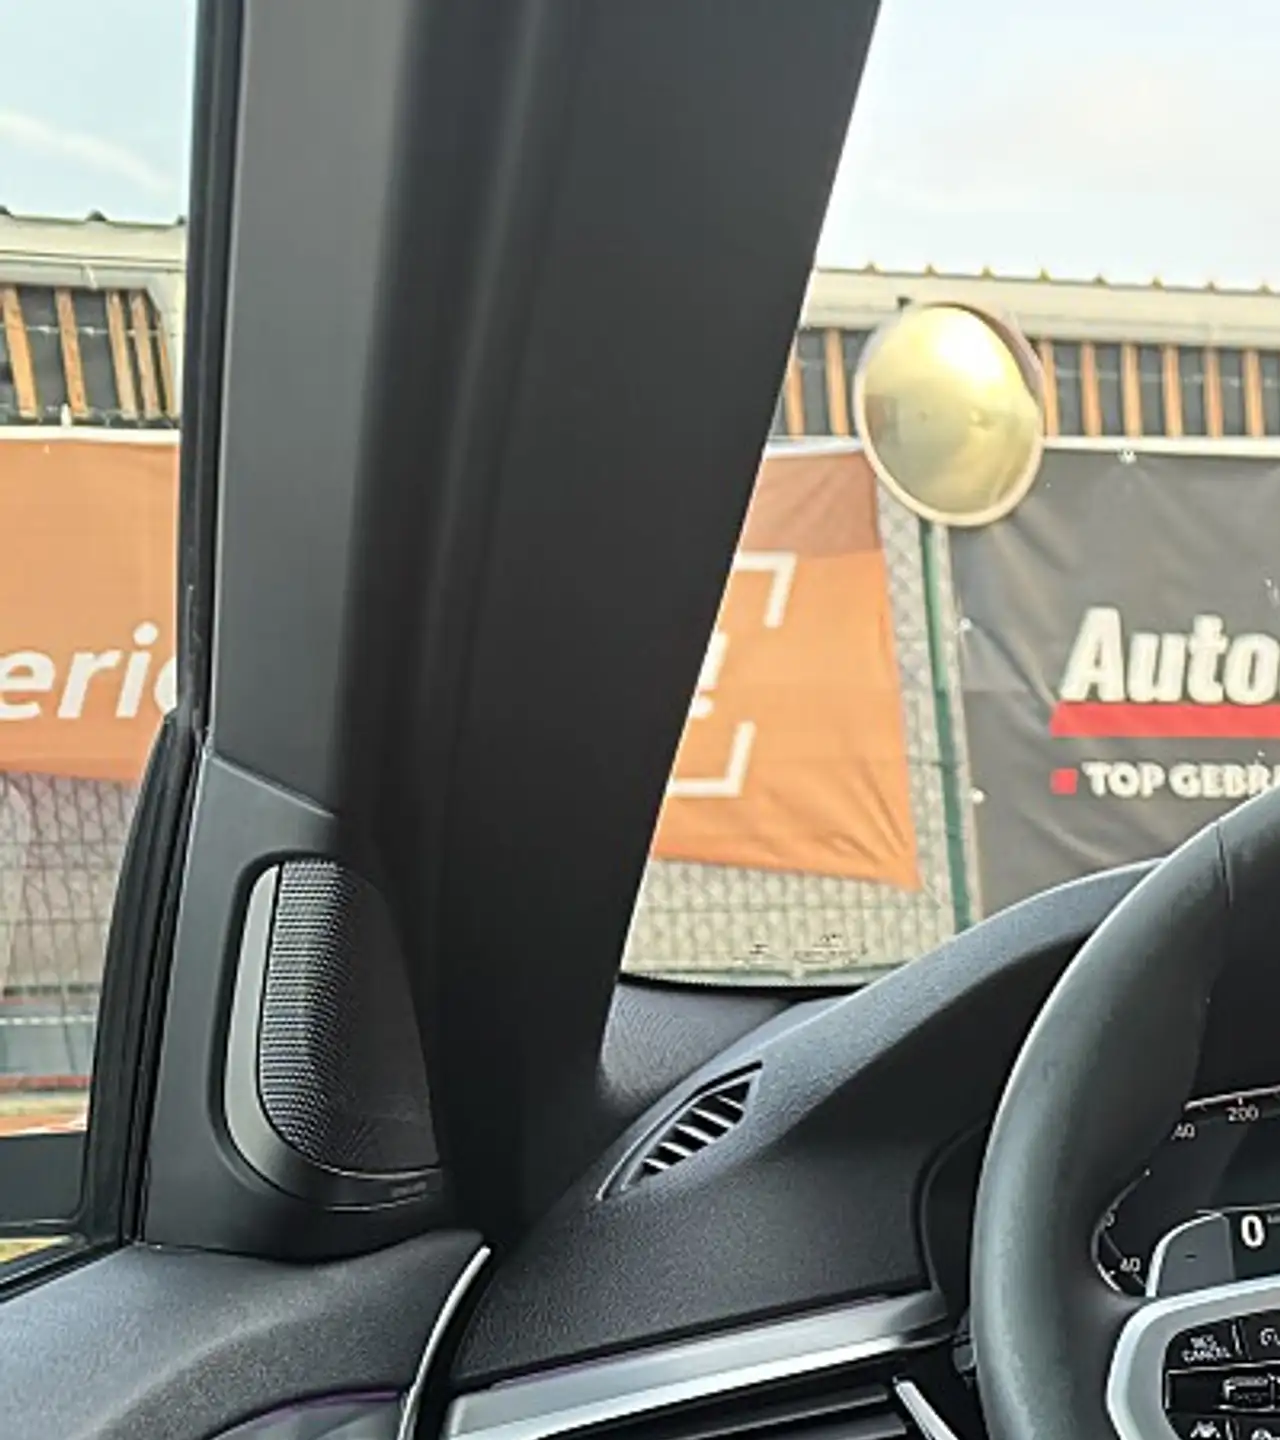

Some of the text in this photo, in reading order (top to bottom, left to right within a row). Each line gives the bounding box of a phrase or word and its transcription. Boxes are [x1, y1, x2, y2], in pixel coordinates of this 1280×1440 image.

[1081, 761, 1165, 797] TOP
[1226, 1104, 1260, 1122] 200
[1240, 1214, 1265, 1248] 0
